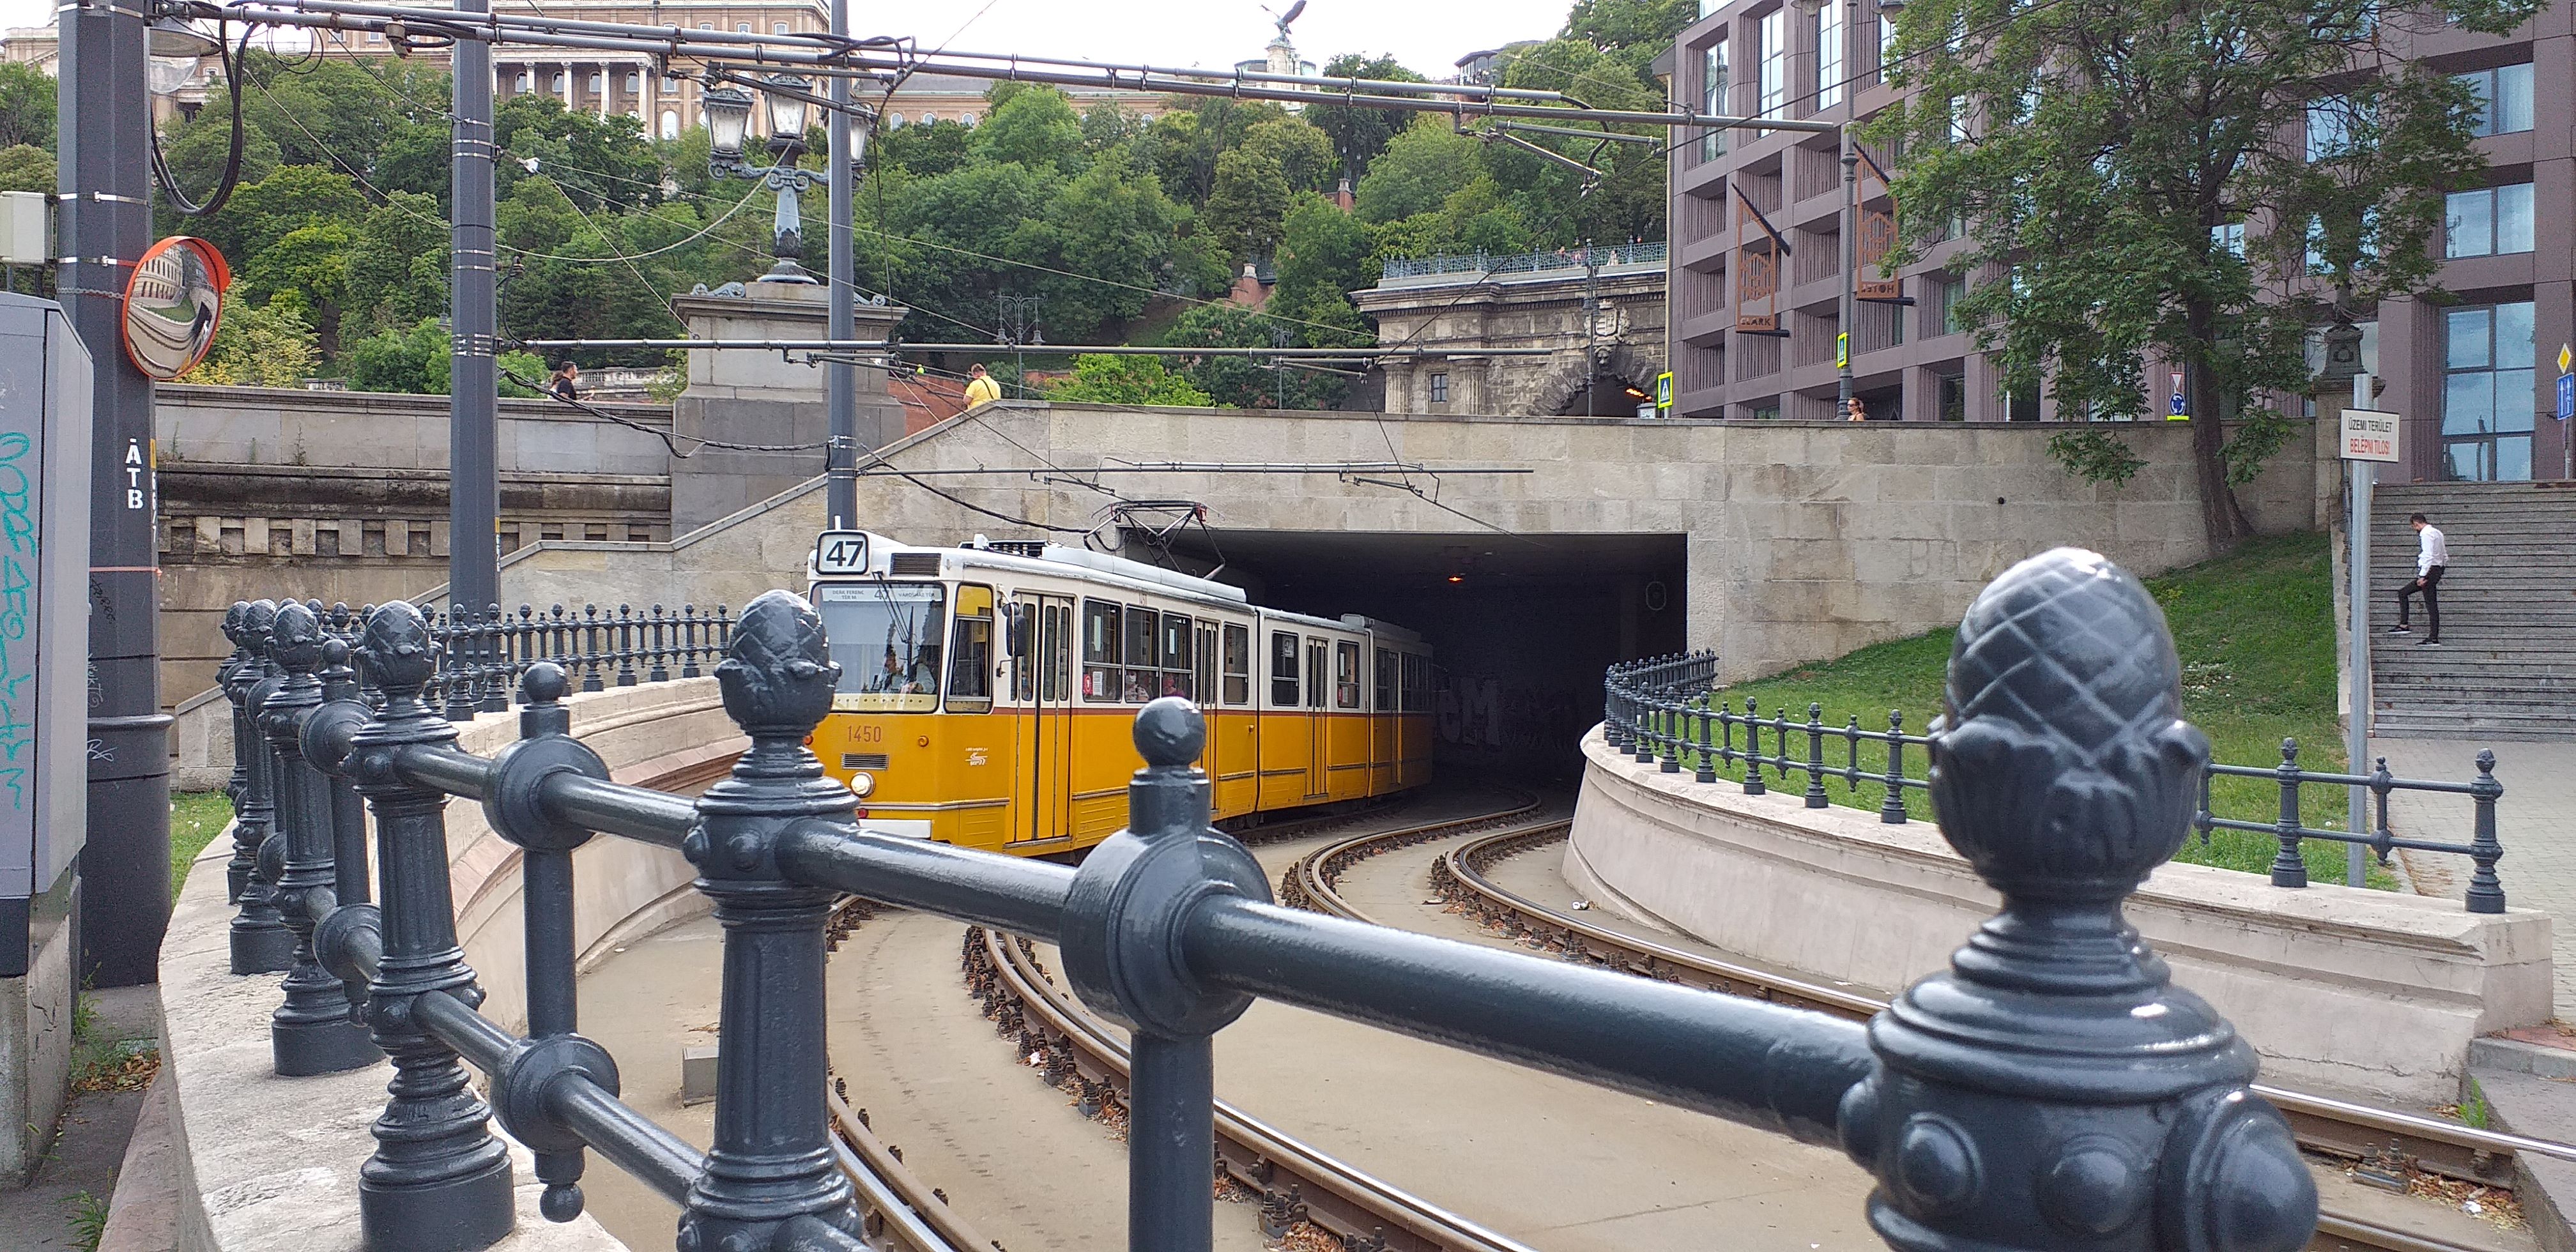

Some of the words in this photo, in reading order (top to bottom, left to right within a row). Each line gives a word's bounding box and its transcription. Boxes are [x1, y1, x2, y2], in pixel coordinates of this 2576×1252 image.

[1740, 317, 1771, 326] CLARK
[2349, 417, 2366, 431] ÜZEMI
[2368, 418, 2392, 432] TERÜLET
[826, 540, 864, 567] 47
[848, 725, 882, 742] 1450
